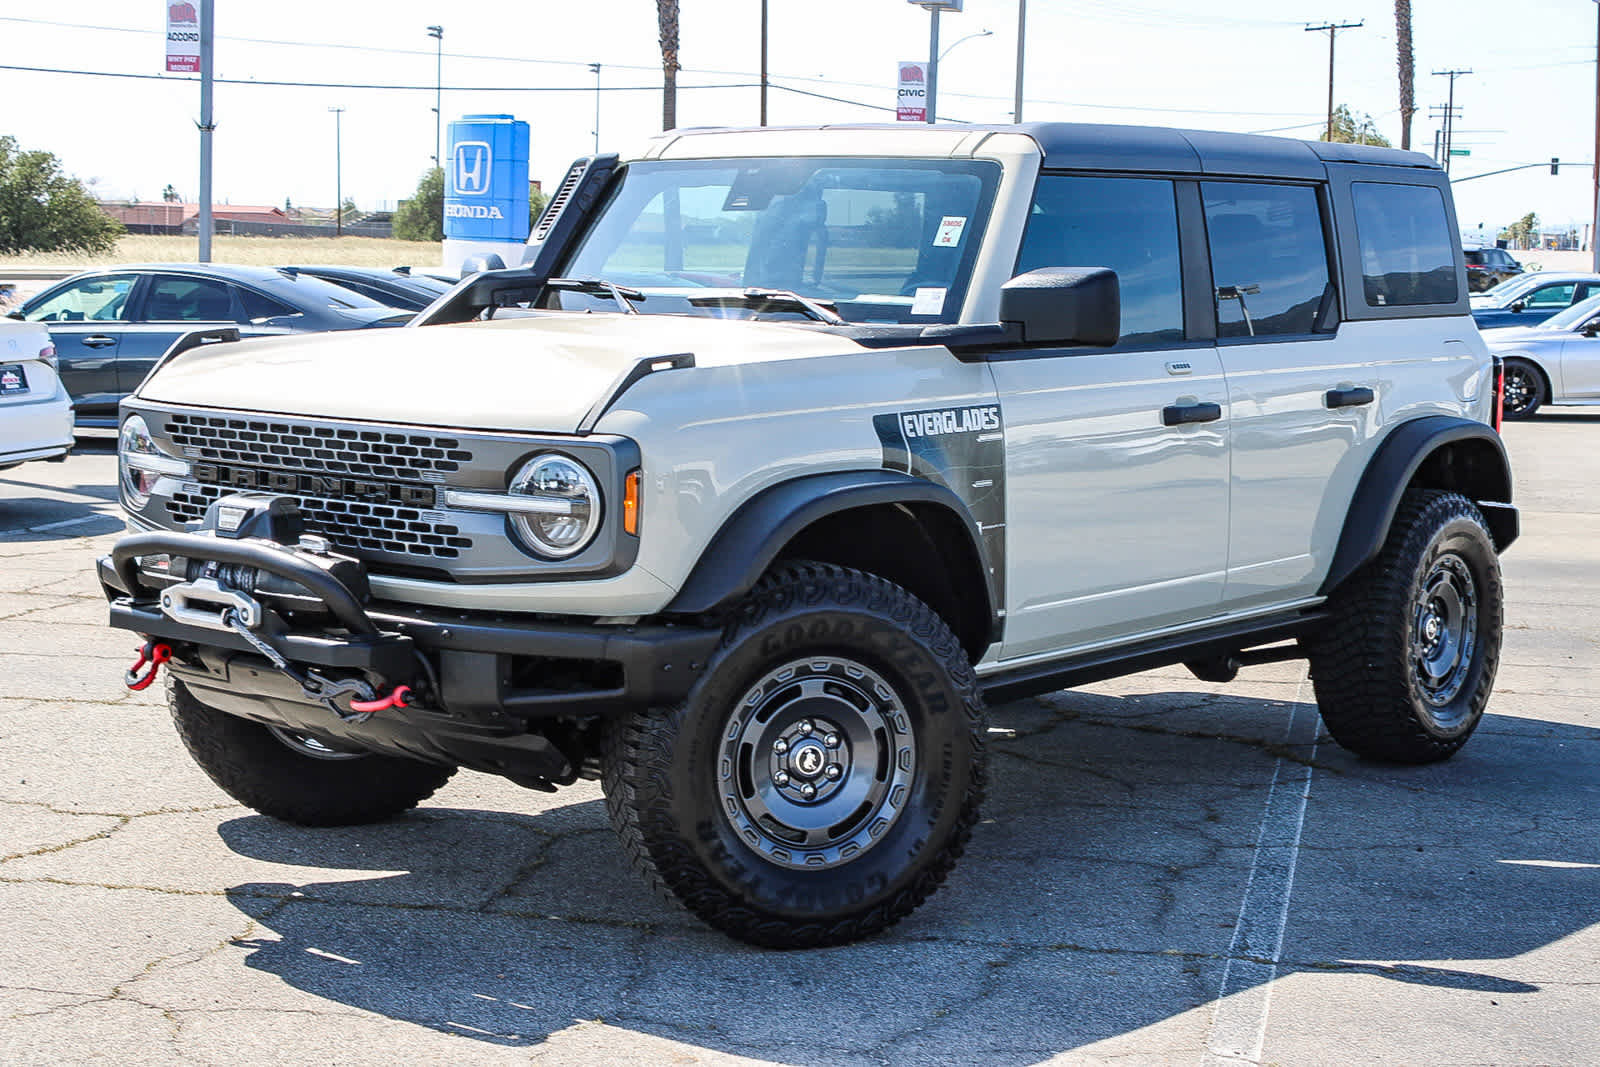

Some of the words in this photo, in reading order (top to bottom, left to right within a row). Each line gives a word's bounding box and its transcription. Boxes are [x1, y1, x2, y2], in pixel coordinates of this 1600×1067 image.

[168, 32, 199, 41] ACCORD
[898, 88, 925, 97] CIVIC
[445, 204, 504, 219] HONDA
[903, 407, 999, 438] EVERGLADES
